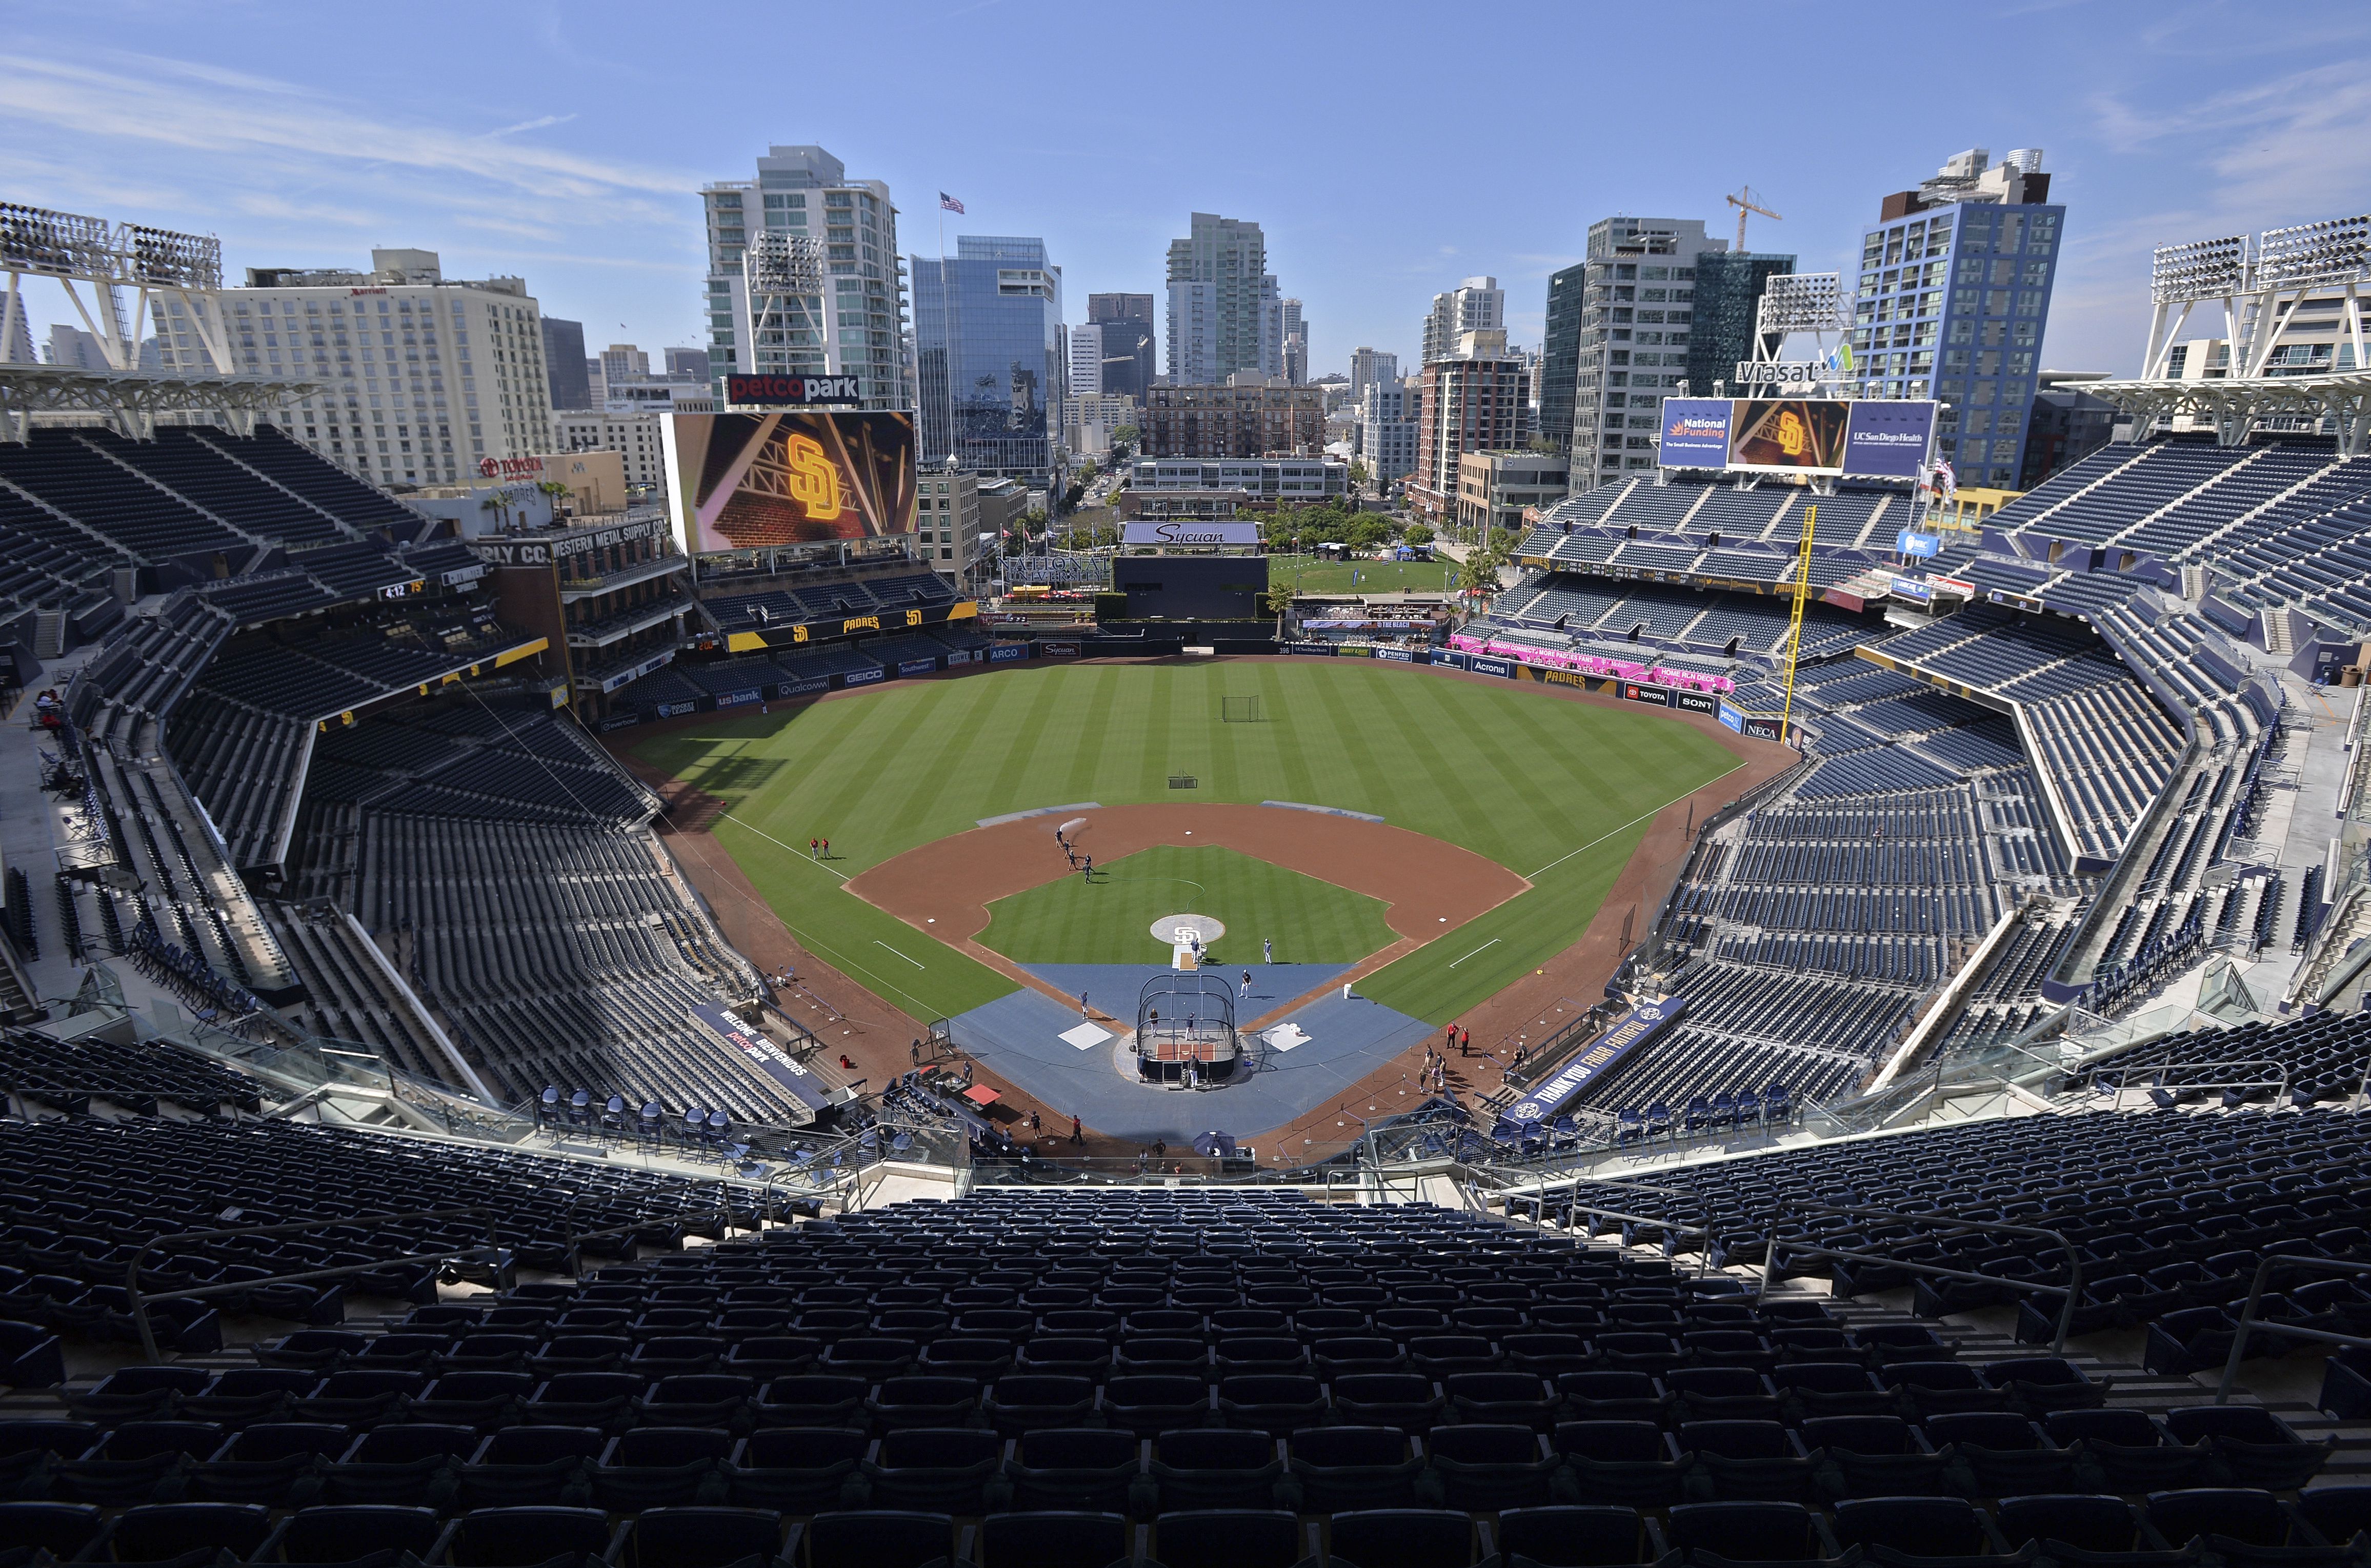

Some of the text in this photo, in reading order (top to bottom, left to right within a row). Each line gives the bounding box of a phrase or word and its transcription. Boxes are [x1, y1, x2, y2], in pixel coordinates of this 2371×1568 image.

[351, 285, 387, 296] Marriott
[1740, 361, 1817, 383] Viasat
[1684, 418, 1726, 429] National
[1683, 428, 1725, 438] Funding
[1854, 432, 1922, 442] UC San Diego Health
[500, 457, 544, 473] TOYOTA
[551, 535, 593, 558] WESTERN
[595, 529, 622, 547] METAL
[623, 522, 650, 541] SUPPLY
[1154, 522, 1225, 548] Sycuan
[996, 556, 1112, 571] NATIONAL
[1521, 556, 1551, 570] PADRES
[1006, 571, 1102, 582] UNIVERSITY
[386, 584, 405, 599] 4:12
[843, 616, 880, 634] PADRES
[1045, 644, 1075, 655] Sycuan
[1490, 641, 1510, 650] NOBODY
[992, 649, 1017, 659] ARCO
[901, 662, 930, 673] Southwest
[1475, 661, 1505, 674] Acronis
[847, 670, 882, 684] GEICO
[1544, 671, 1585, 690] PADRES
[1661, 668, 1716, 682] HOME RUN DECK
[780, 681, 828, 696] Qualcomm
[1640, 691, 1665, 700] TOYOTA
[672, 702, 694, 710] ROCKET
[1682, 698, 1712, 709] SONY
[672, 707, 695, 715] LEAGUE
[1721, 710, 1734, 723] petco
[610, 717, 637, 728] everbowl
[1747, 725, 1777, 738] NECA
[720, 1010, 808, 1076] WELCOME BIENVENIDOS
[1533, 1020, 1650, 1104] THANK YOU FRIAR FAITHFUL
